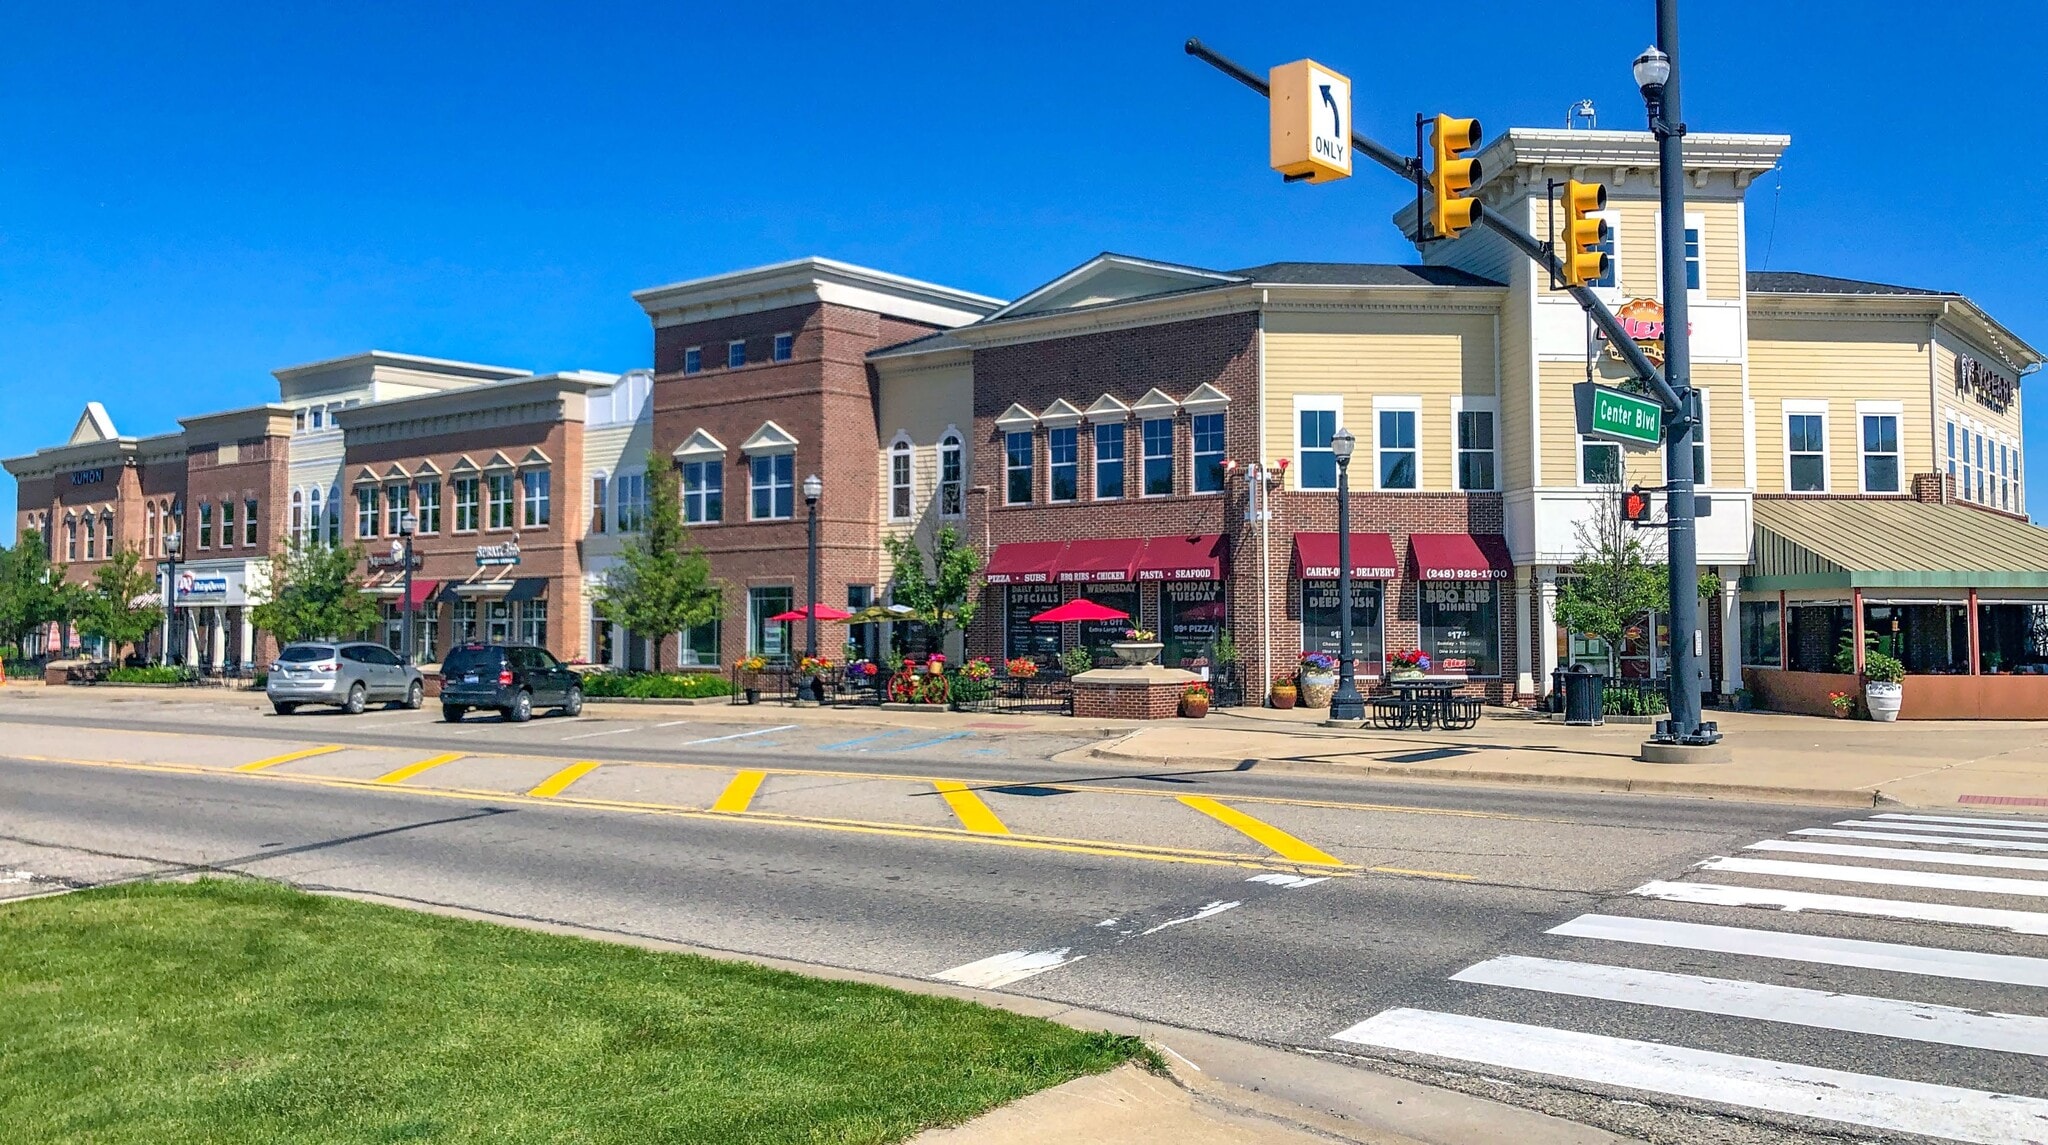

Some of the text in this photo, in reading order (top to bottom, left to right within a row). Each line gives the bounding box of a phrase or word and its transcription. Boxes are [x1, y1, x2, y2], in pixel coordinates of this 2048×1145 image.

[1315, 136, 1343, 161] ONLY
[1601, 400, 1655, 431] Center Blvd
[72, 469, 102, 485] KUMON
[1060, 571, 1125, 581] BBQ RIBS CHICKEN
[1140, 569, 1211, 579] PASTA SEAFOOD
[1306, 567, 1395, 577] CARRY-O DELIVERY
[1426, 568, 1507, 580] (248) 926-1700
[988, 573, 1046, 583] PIZZA SUBS
[1012, 584, 1058, 593] DAILY DRINK
[1086, 583, 1136, 593] WEDNESDAY
[1166, 581, 1221, 592] MONDAY &
[1309, 581, 1374, 589] LARGE UARE
[1425, 581, 1490, 590] WHOLE SLAB
[1171, 591, 1216, 601] TUESDAY
[1323, 589, 1361, 597] DETIT
[1426, 590, 1490, 603] BBQ RIB
[1011, 594, 1059, 603] SPECIALS
[1309, 597, 1340, 608] DEEP
[1439, 603, 1478, 612] DINNER
